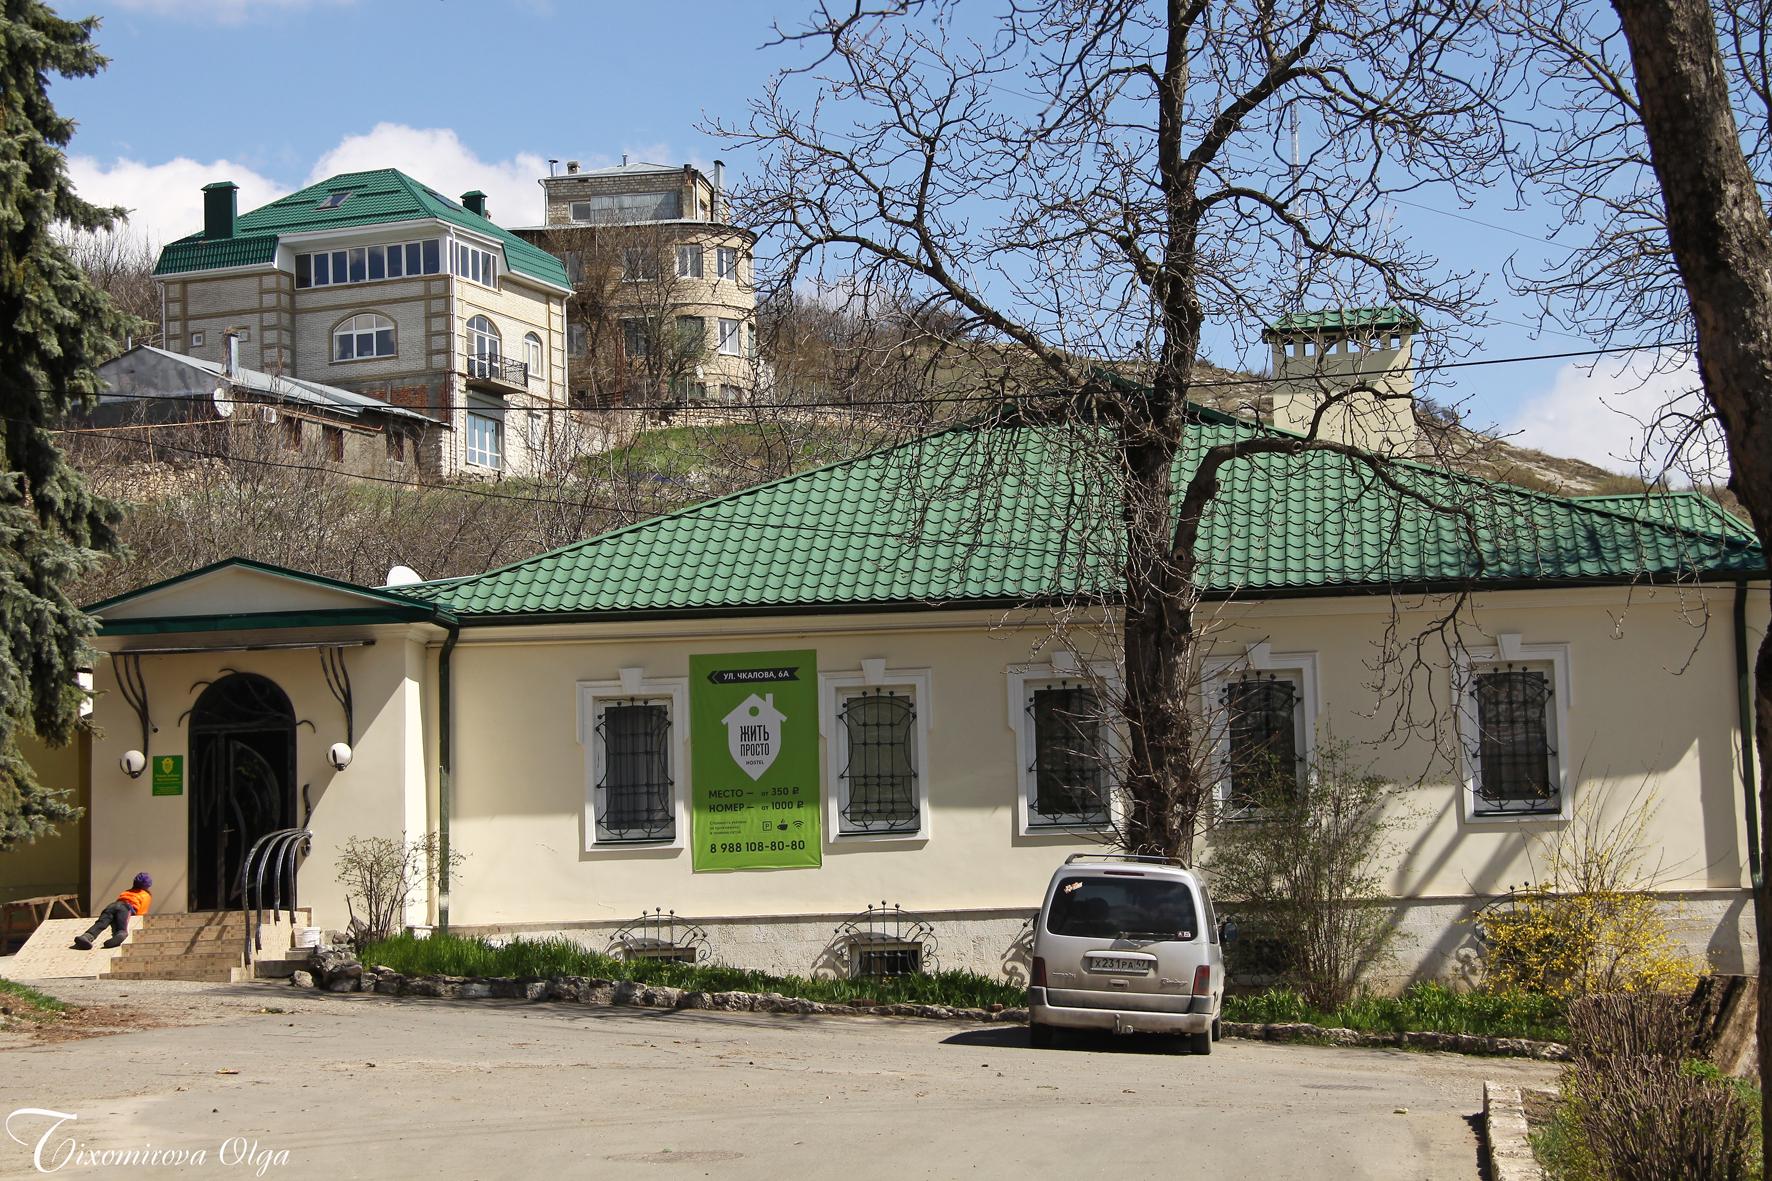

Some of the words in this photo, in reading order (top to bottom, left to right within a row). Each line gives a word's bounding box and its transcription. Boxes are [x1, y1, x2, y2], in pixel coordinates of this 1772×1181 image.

[737, 671, 777, 680] ЧКАЛОВА,
[778, 670, 789, 678] 6А
[740, 724, 770, 742] ЖИТЬ
[740, 743, 770, 757] ПРОСТО
[708, 789, 744, 799] МЕСТО
[771, 787, 789, 796] 350
[709, 803, 745, 813] НОМЕР
[771, 801, 794, 810] 1000
[710, 843, 717, 854] 8
[720, 842, 742, 853] 988
[746, 840, 805, 852] 108-80-80
